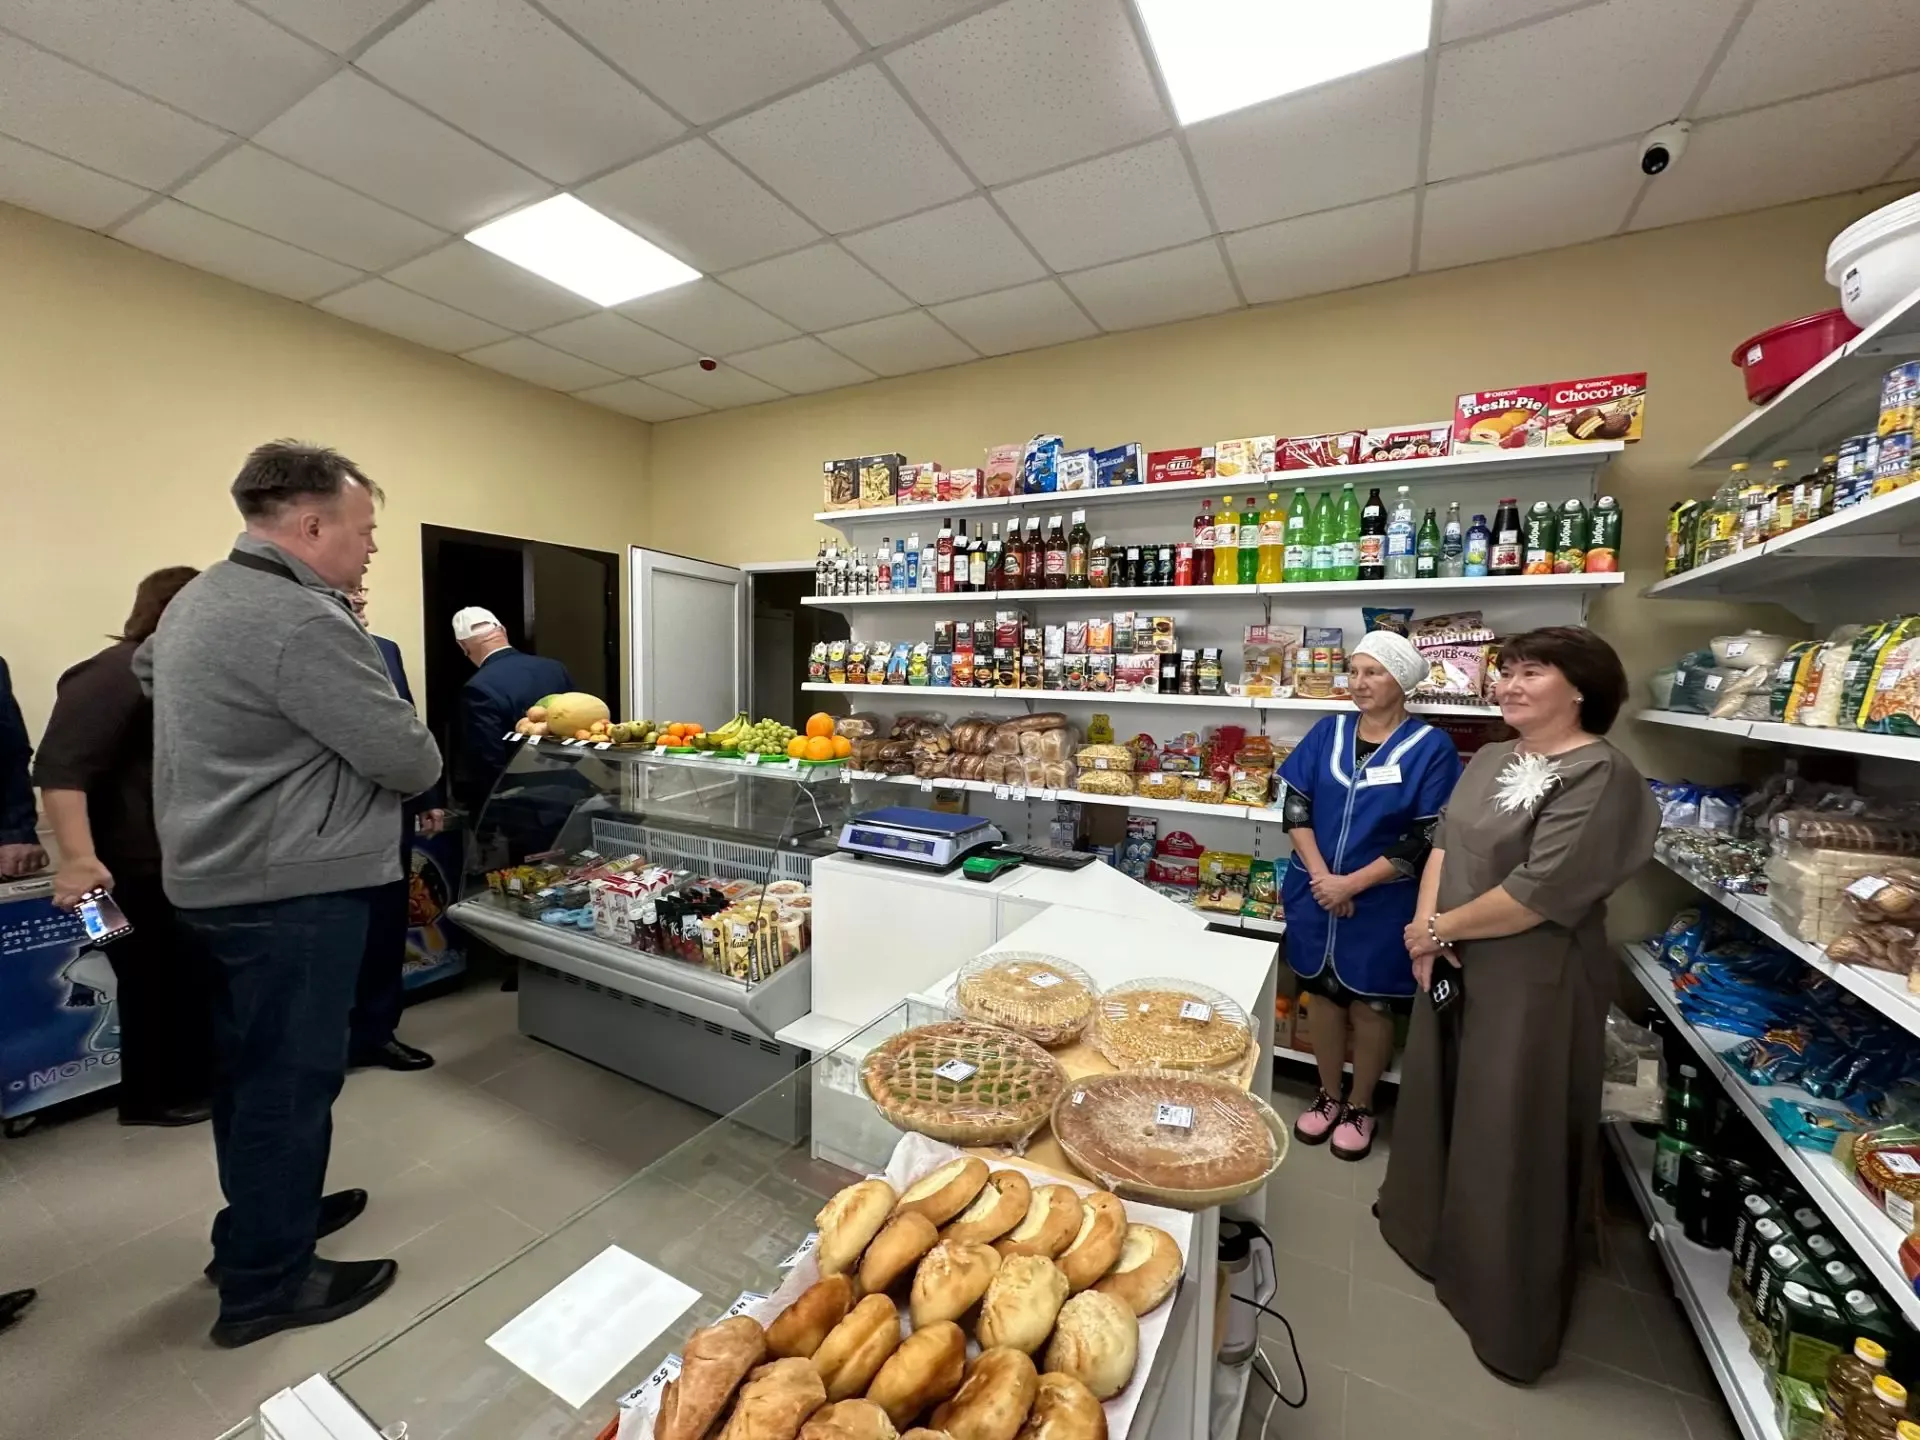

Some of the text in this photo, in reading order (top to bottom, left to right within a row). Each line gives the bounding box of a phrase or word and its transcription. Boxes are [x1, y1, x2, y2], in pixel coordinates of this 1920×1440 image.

[1560, 518, 1572, 546] Добрый
[1591, 516, 1605, 545] Добрый
[32, 1050, 121, 1089] МОРО
